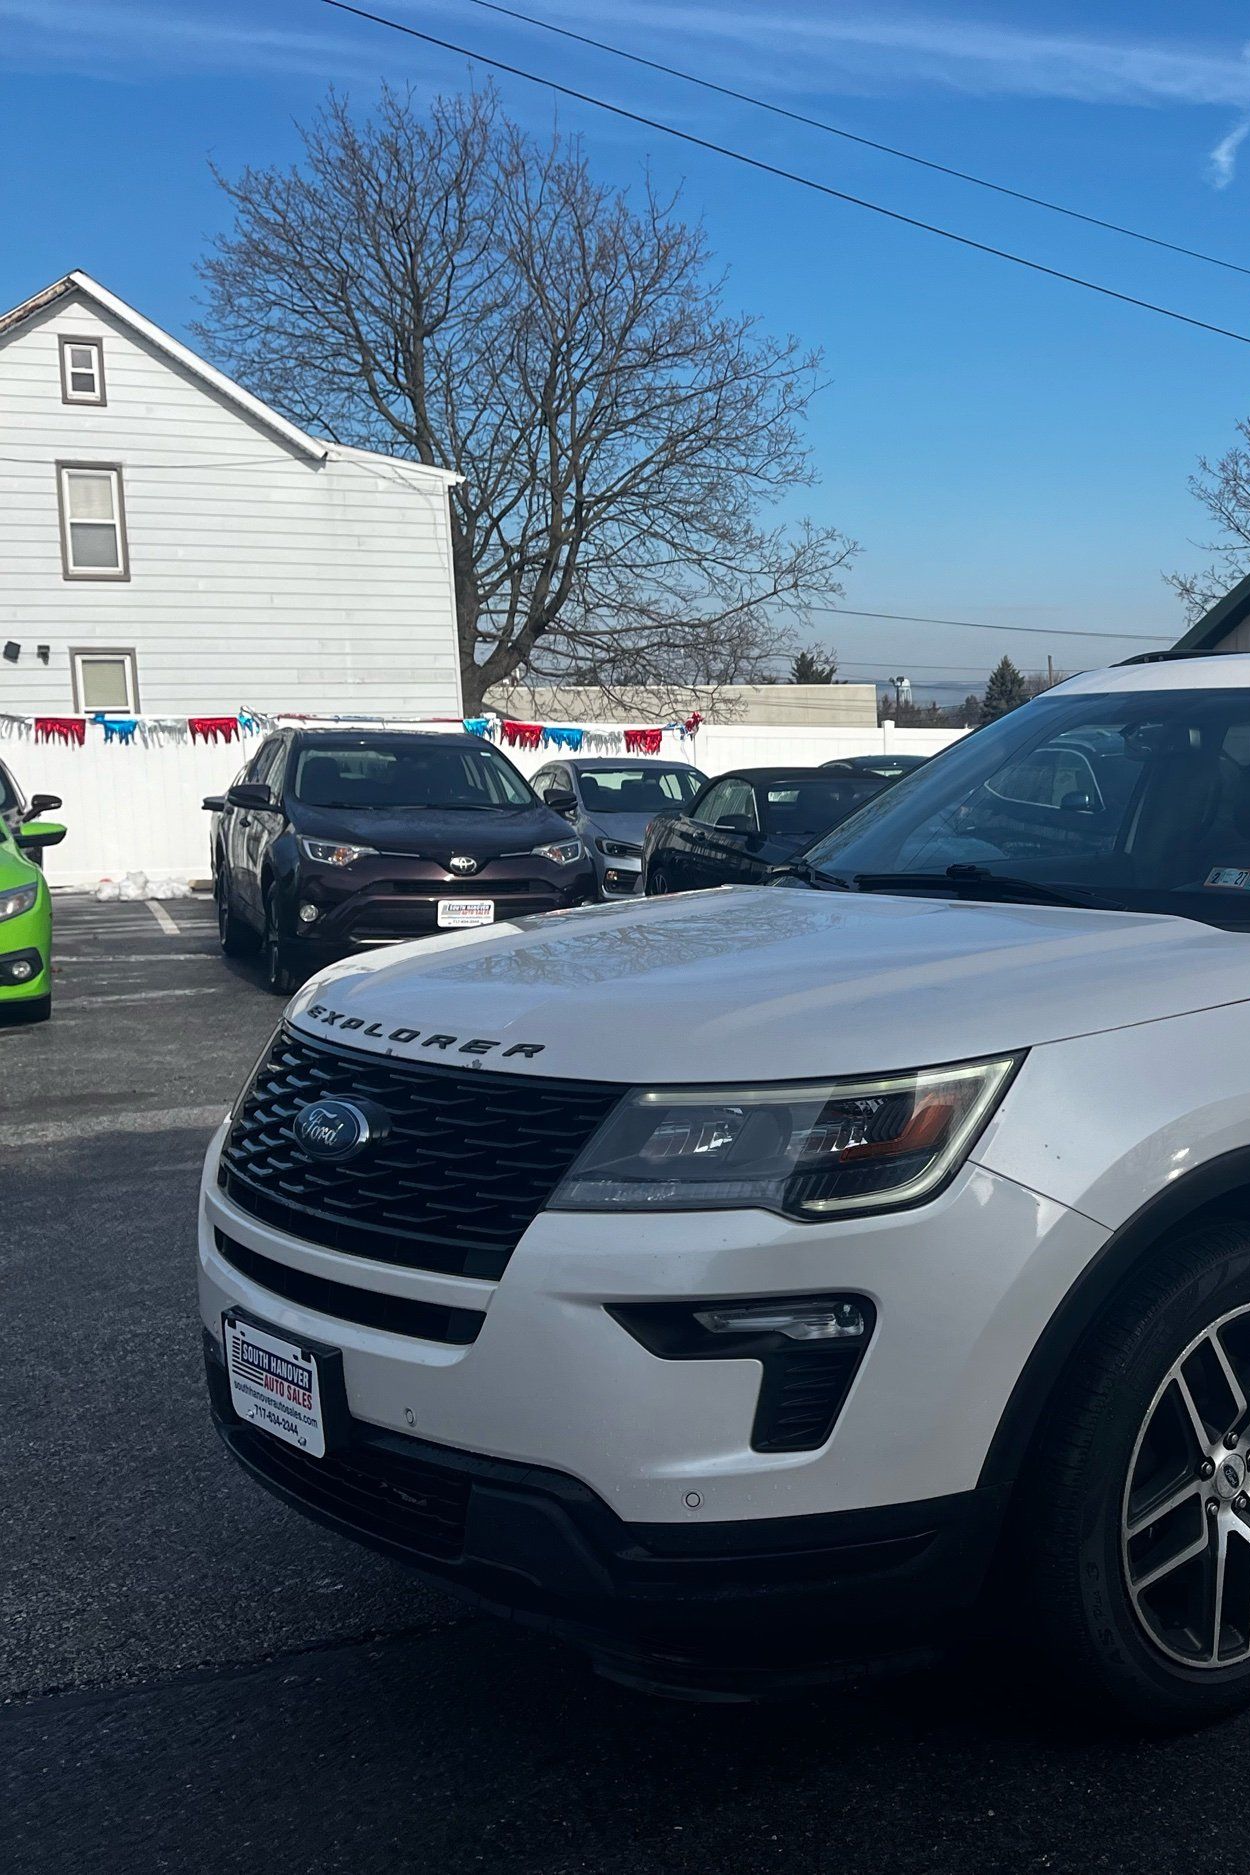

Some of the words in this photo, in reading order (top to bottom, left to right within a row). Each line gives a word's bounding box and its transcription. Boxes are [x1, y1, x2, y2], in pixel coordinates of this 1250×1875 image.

[1234, 872, 1249, 885] 27
[306, 1004, 546, 1059] EXPLORER
[302, 1107, 344, 1146] Ford
[242, 1343, 269, 1371] SOUTH
[270, 1357, 309, 1389] HANOVER
[234, 1380, 319, 1428] southhanoverautosales.com
[264, 1374, 285, 1398] AUTO
[286, 1383, 312, 1411] SALES
[254, 1404, 299, 1436] 717-634-2344
